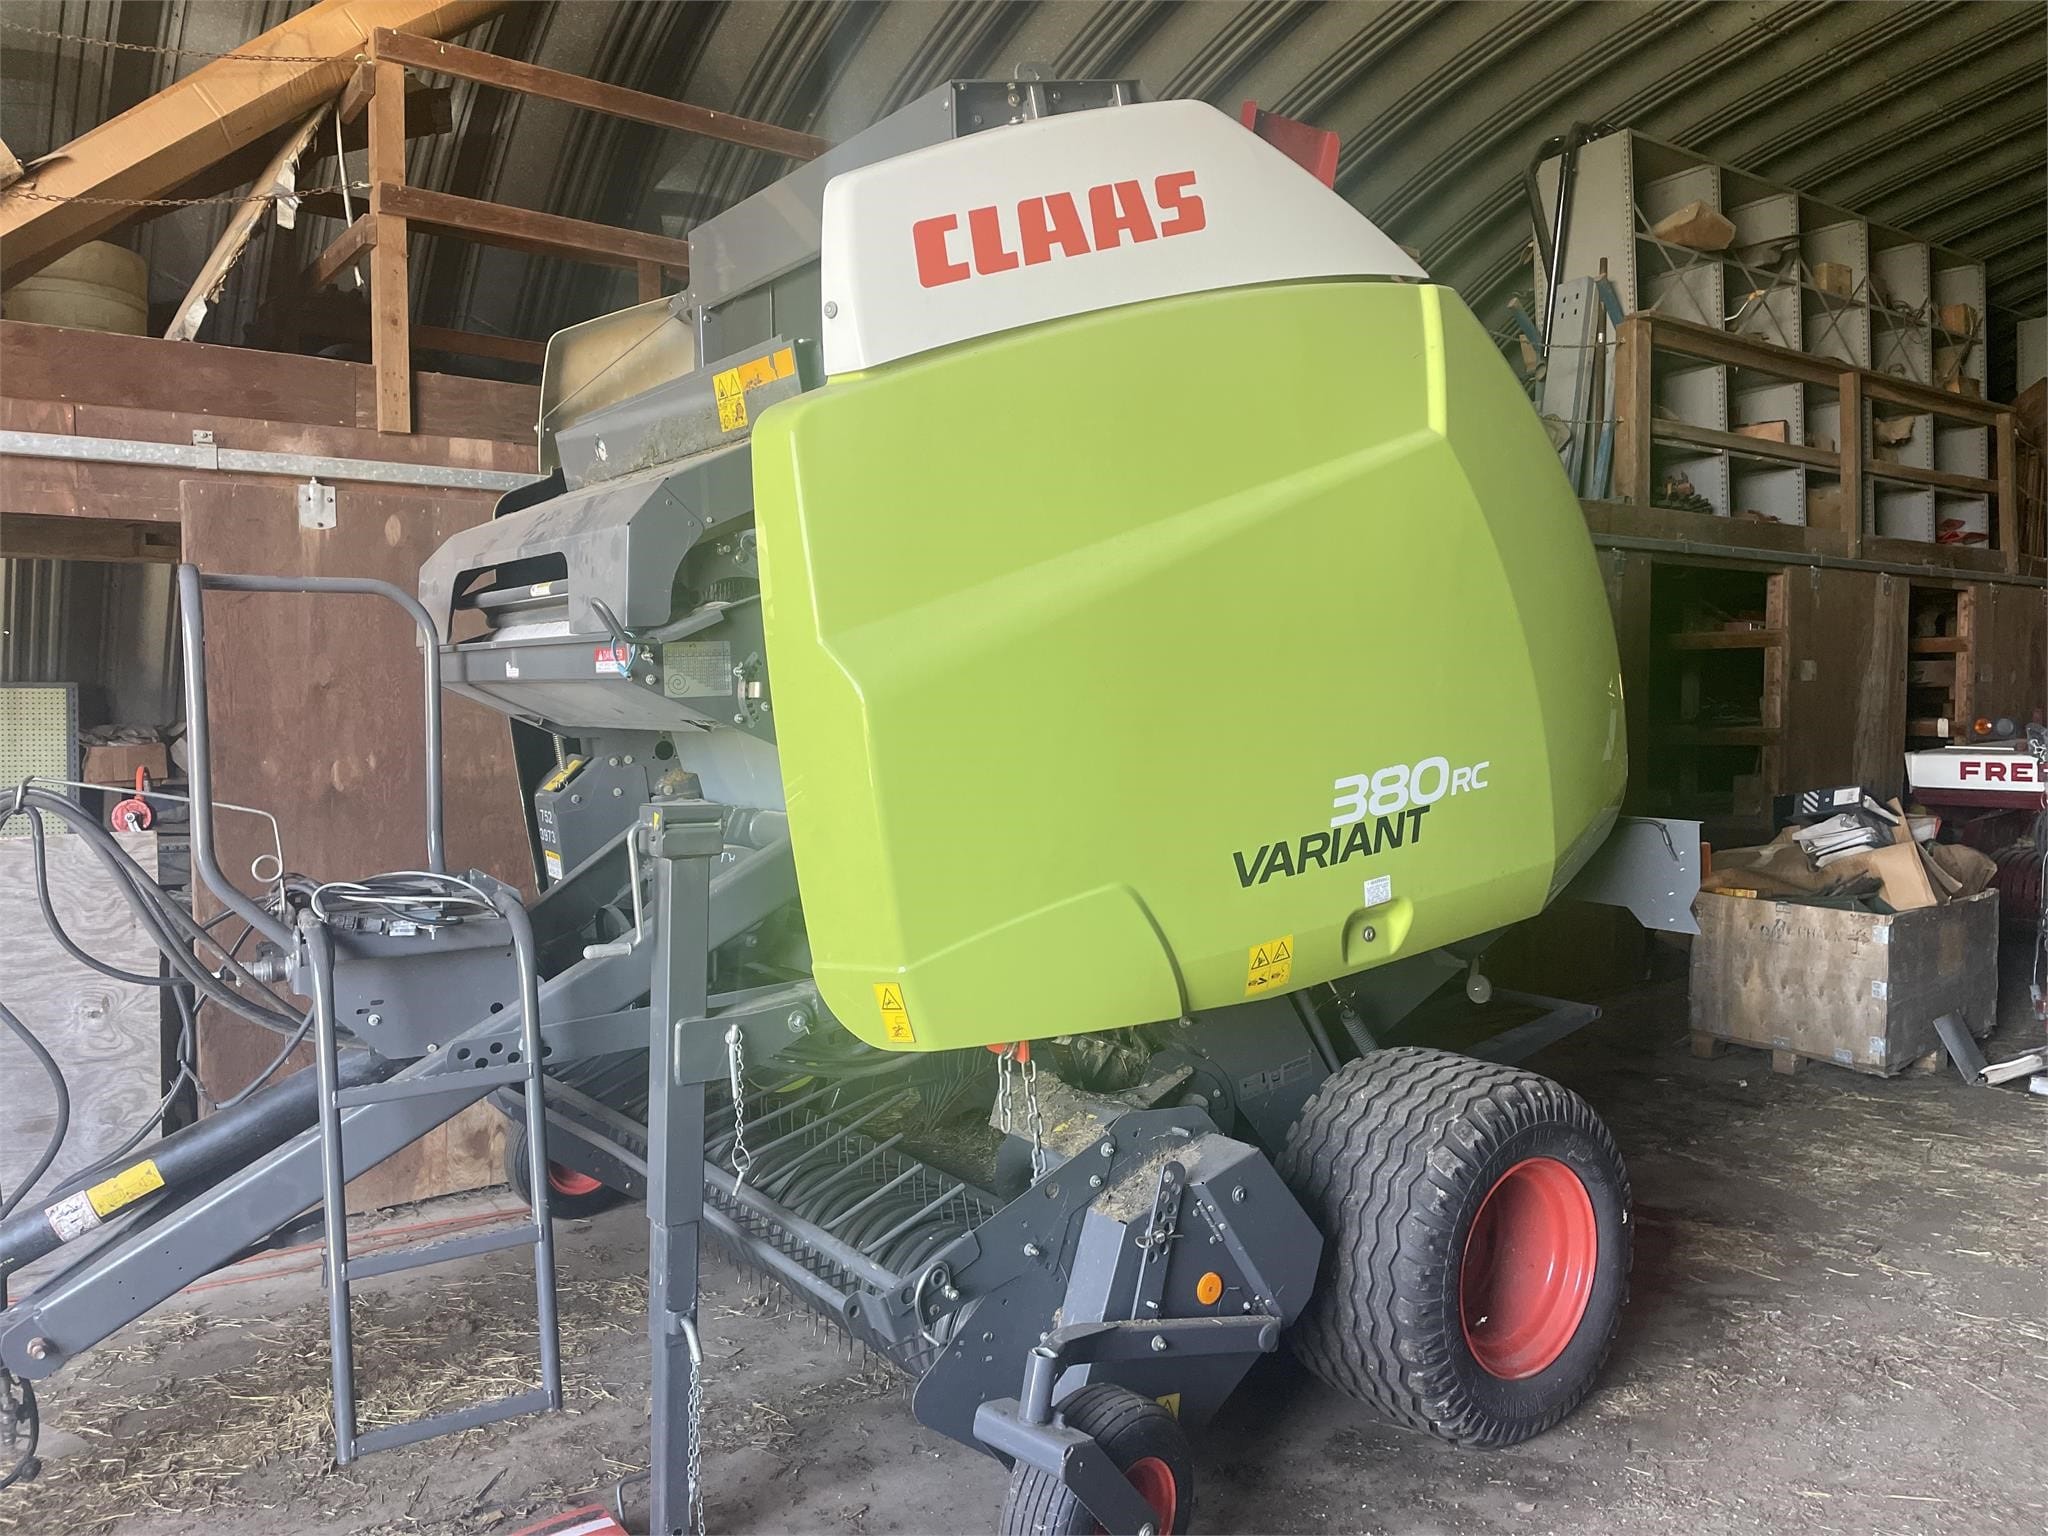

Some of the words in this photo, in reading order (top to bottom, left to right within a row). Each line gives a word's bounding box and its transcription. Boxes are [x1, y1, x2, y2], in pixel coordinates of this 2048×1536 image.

[913, 171, 1206, 288] CLAAS
[539, 809, 553, 824] 752
[1233, 805, 1431, 888] VARIANT
